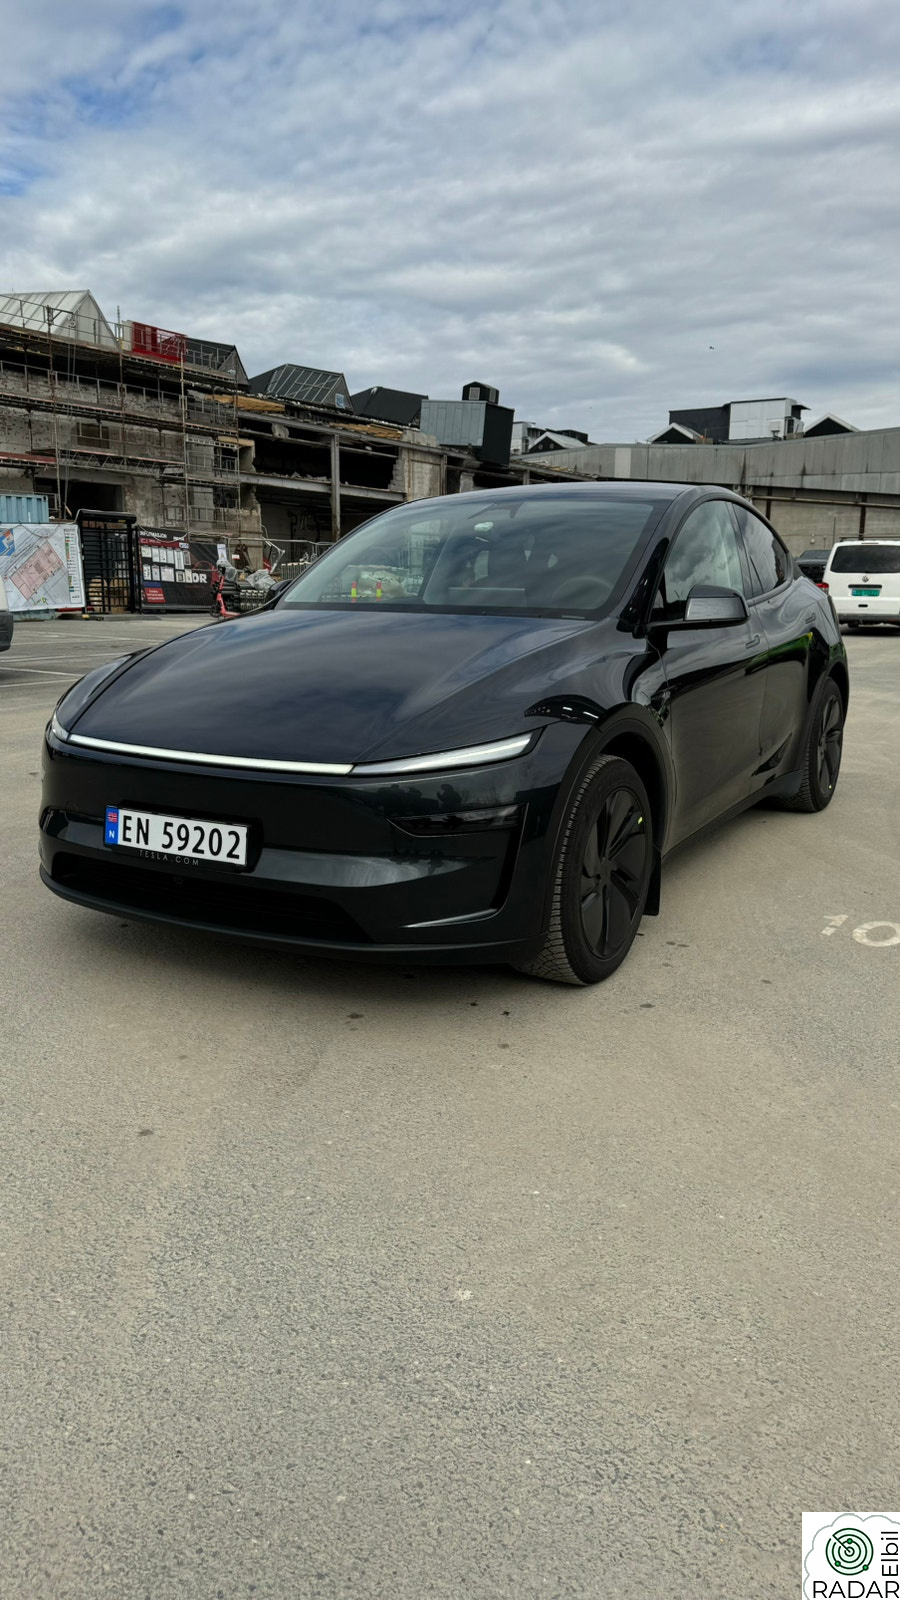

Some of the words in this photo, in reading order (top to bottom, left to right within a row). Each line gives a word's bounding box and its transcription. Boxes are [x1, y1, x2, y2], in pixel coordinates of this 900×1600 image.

[109, 830, 115, 838] N
[122, 815, 150, 845] EN
[161, 821, 240, 860] 59202
[139, 850, 199, 866] TESLA.COM
